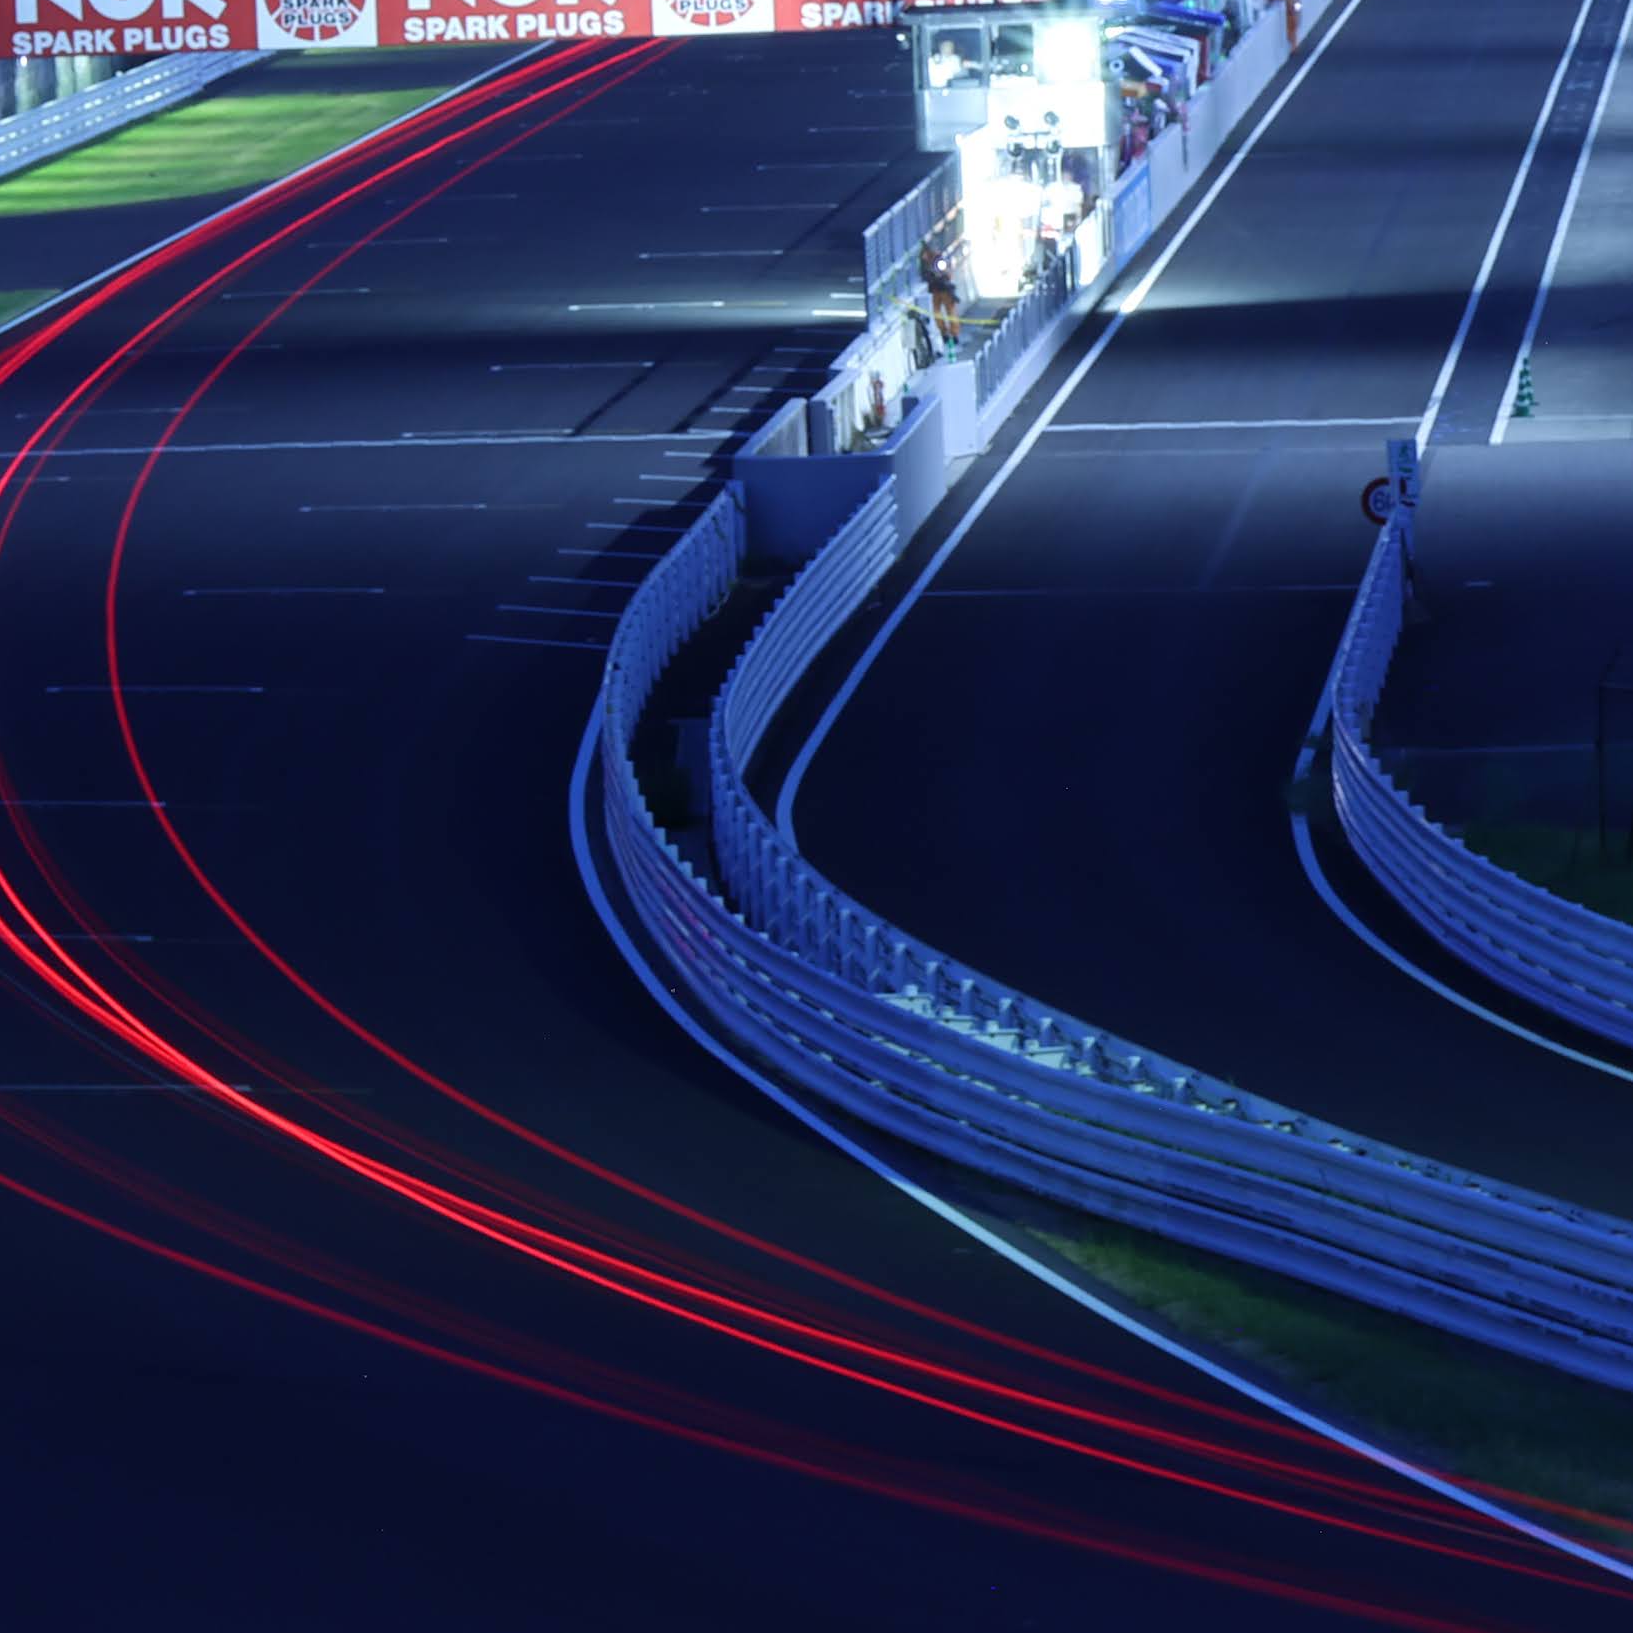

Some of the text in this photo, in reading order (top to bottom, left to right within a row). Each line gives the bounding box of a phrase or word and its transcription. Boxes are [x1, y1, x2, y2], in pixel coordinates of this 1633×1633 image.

[284, 12, 350, 25] PLUGS
[404, 10, 625, 43] SPARK PLUGS
[12, 23, 230, 56] SPARK PLUGS
